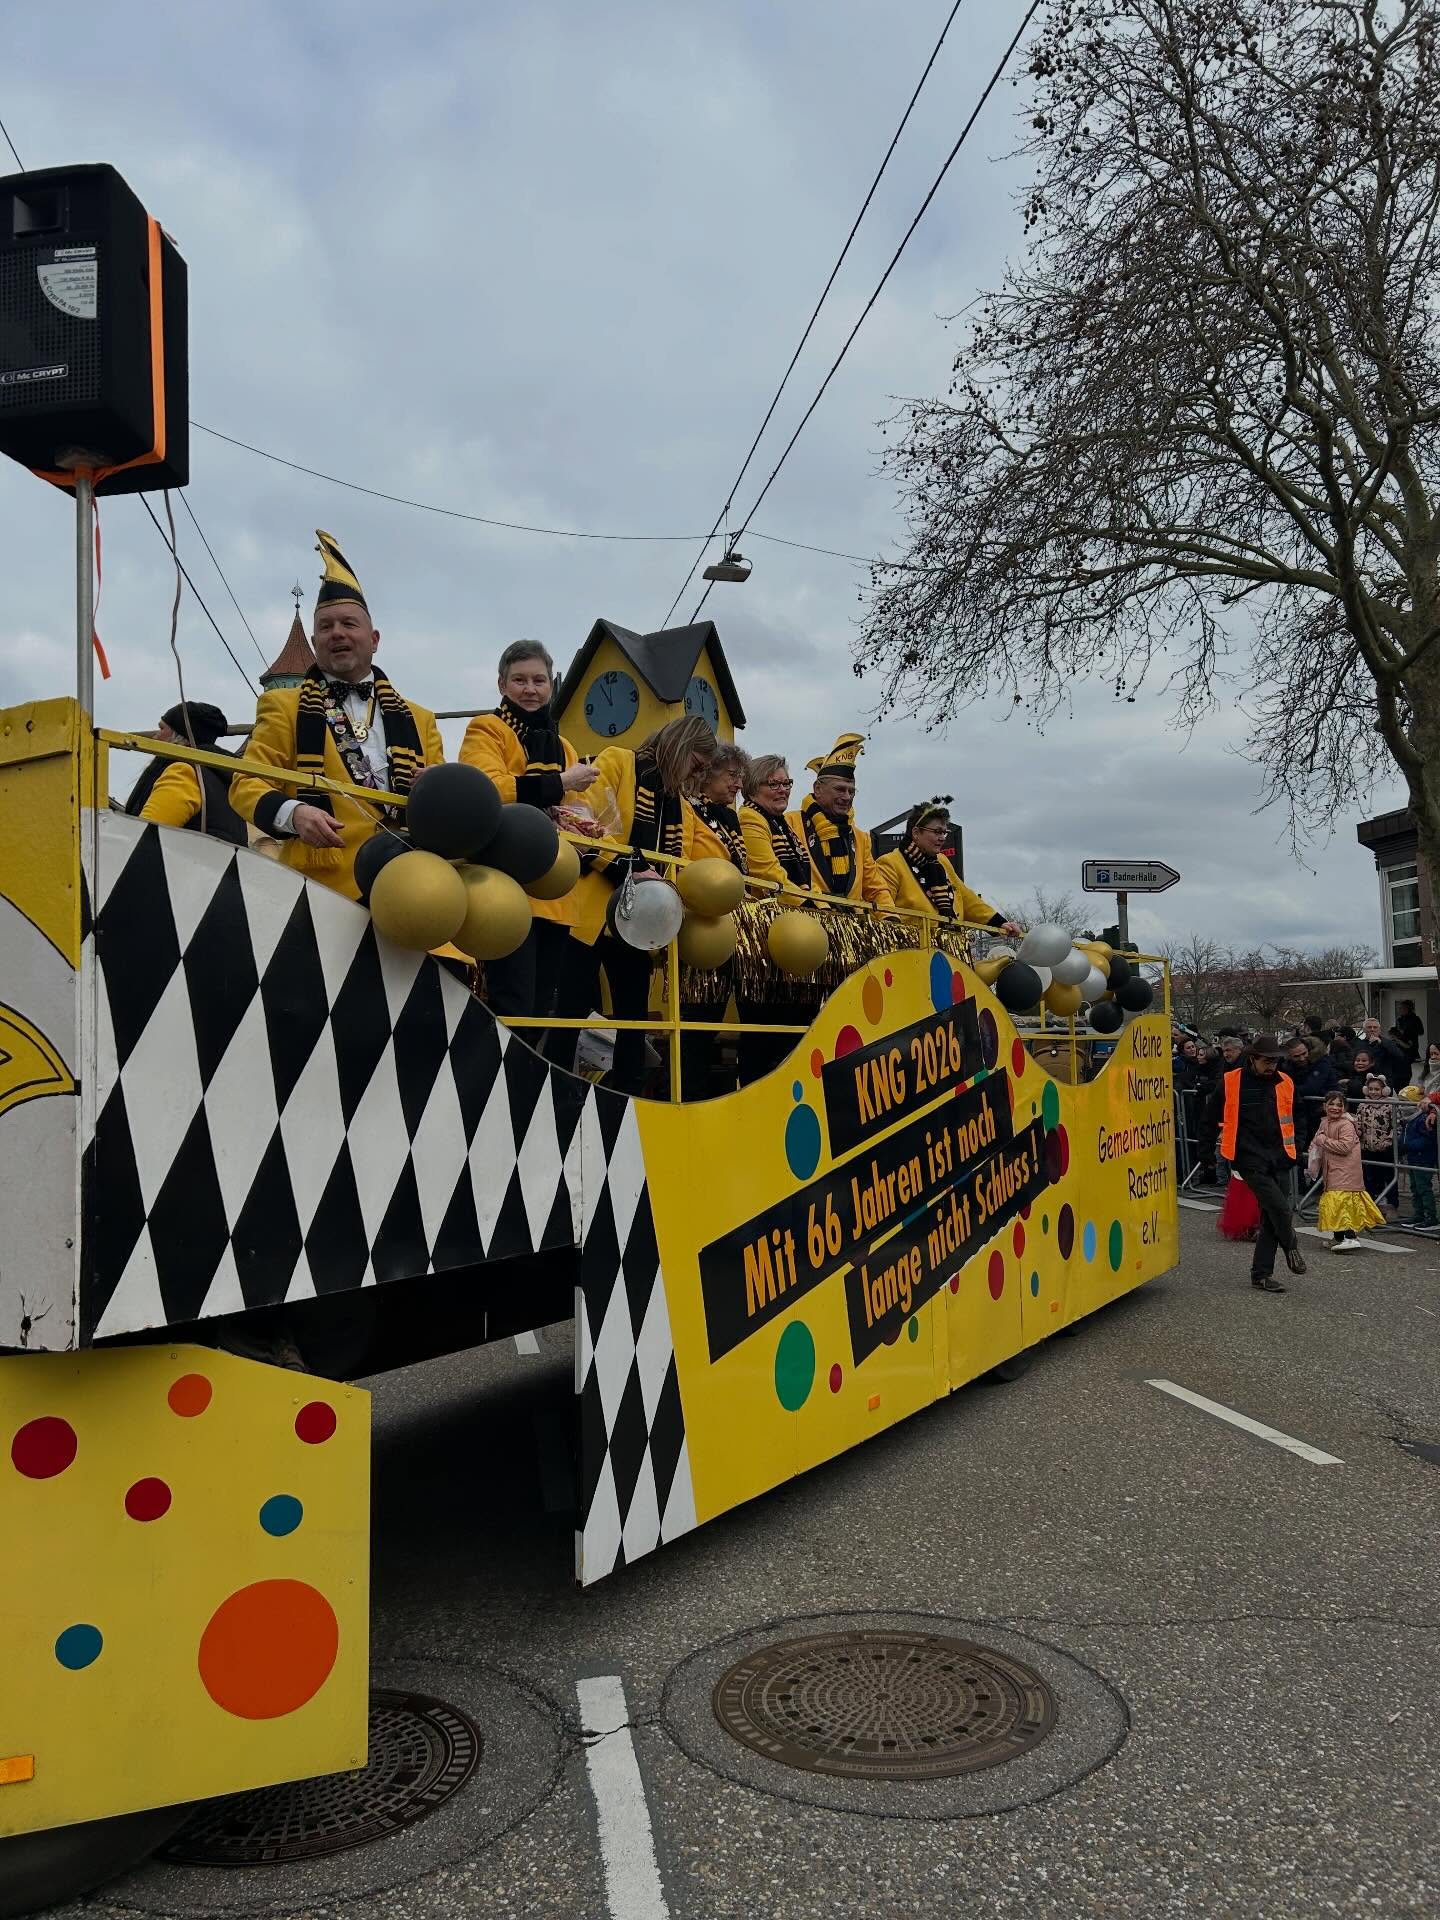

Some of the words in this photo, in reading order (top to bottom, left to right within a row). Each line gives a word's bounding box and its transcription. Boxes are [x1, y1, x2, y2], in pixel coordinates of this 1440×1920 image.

[17, 372, 31, 380] Mc
[32, 367, 65, 379] CRYPT
[604, 671, 617, 684] 12
[586, 704, 594, 715] 9
[630, 690, 637, 703] 3
[608, 724, 616, 735] 6
[835, 752, 853, 763] KNG
[1113, 871, 1157, 882] BadnerHalle
[1132, 1024, 1163, 1060] Kleine
[854, 1046, 906, 1126] KNG
[910, 1021, 962, 1089] 2026
[1127, 1068, 1170, 1103] Narren-
[1098, 1109, 1171, 1164] Gemeinschaft
[1127, 1161, 1168, 1200] Rastatt
[743, 1225, 798, 1318] Mit
[807, 1193, 842, 1270] 66
[850, 1161, 923, 1242] Jahren
[925, 1128, 953, 1183] ist
[958, 1099, 996, 1162] noch
[861, 1246, 922, 1330] lange
[927, 1196, 973, 1262] nicht
[975, 1153, 1030, 1226] Schluss
[1142, 1211, 1161, 1245] e.V.
